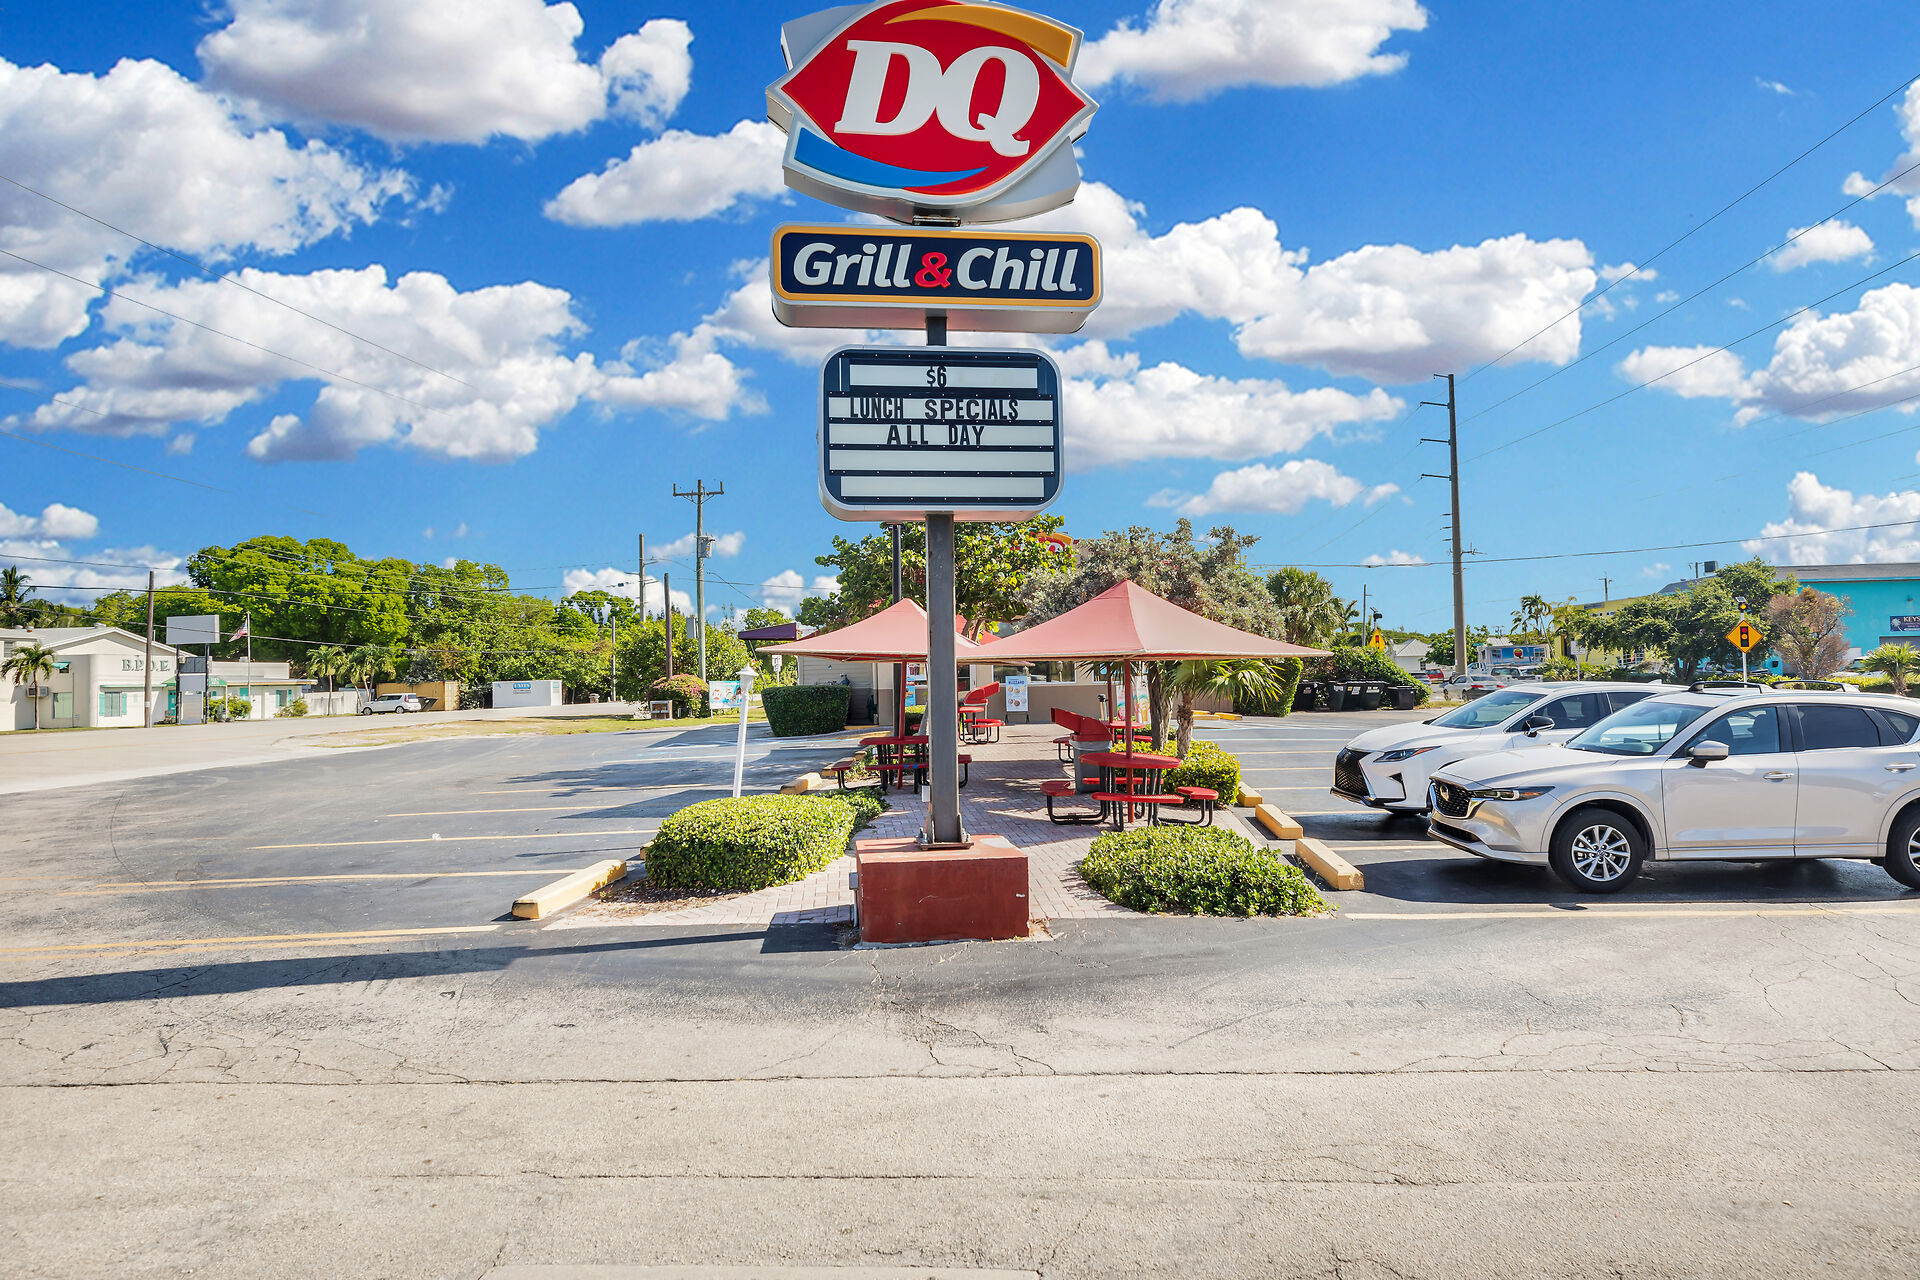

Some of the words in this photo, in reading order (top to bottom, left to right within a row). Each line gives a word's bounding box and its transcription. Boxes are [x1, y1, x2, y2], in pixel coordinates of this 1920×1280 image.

[834, 39, 1040, 157] DQ
[926, 365, 947, 388] $6
[850, 397, 904, 419] LUNCH
[924, 398, 1019, 421] SPECIALS
[886, 424, 929, 445] ALL
[948, 425, 985, 446] DAY
